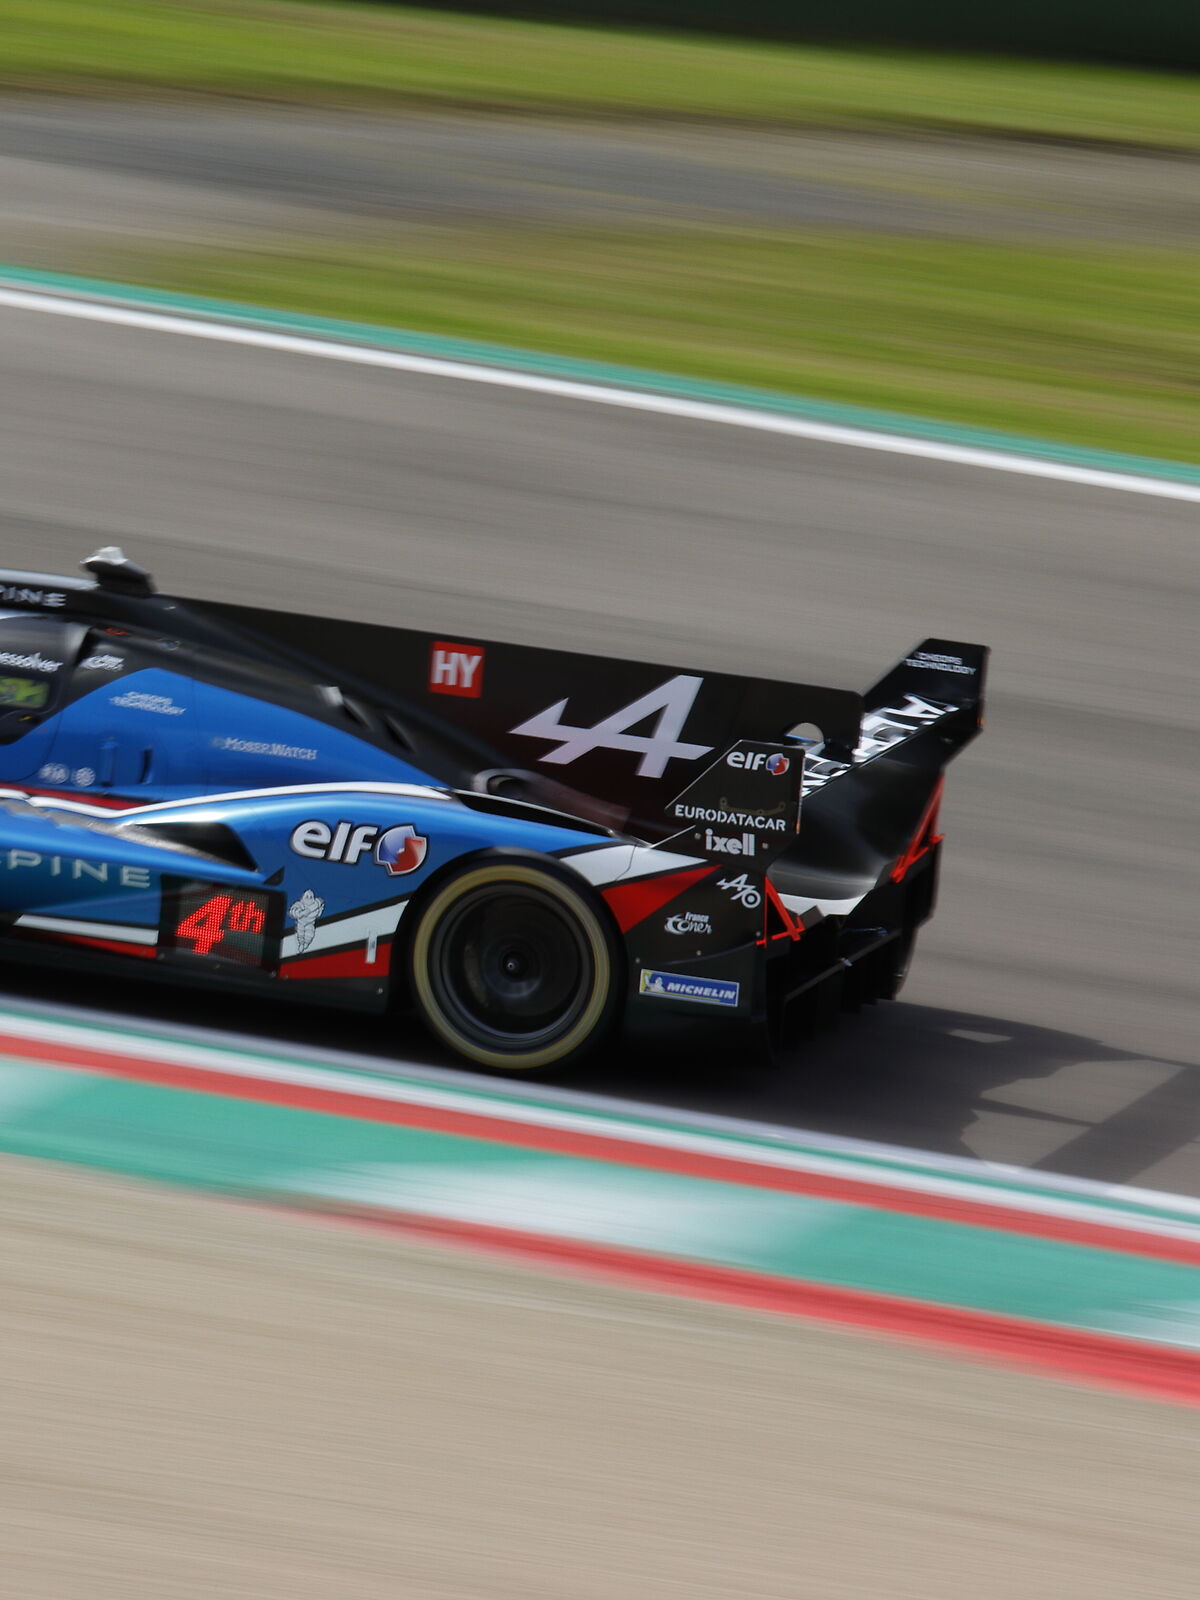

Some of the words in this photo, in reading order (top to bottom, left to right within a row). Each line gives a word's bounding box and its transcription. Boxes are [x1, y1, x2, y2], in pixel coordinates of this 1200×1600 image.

[431, 650, 482, 688] HY
[726, 751, 767, 771] elf
[674, 804, 786, 831] EURODATACAR
[290, 820, 379, 864] elf
[705, 828, 755, 856] ixell
[174, 893, 267, 956] 4th
[666, 982, 737, 1000] MICHELIN
